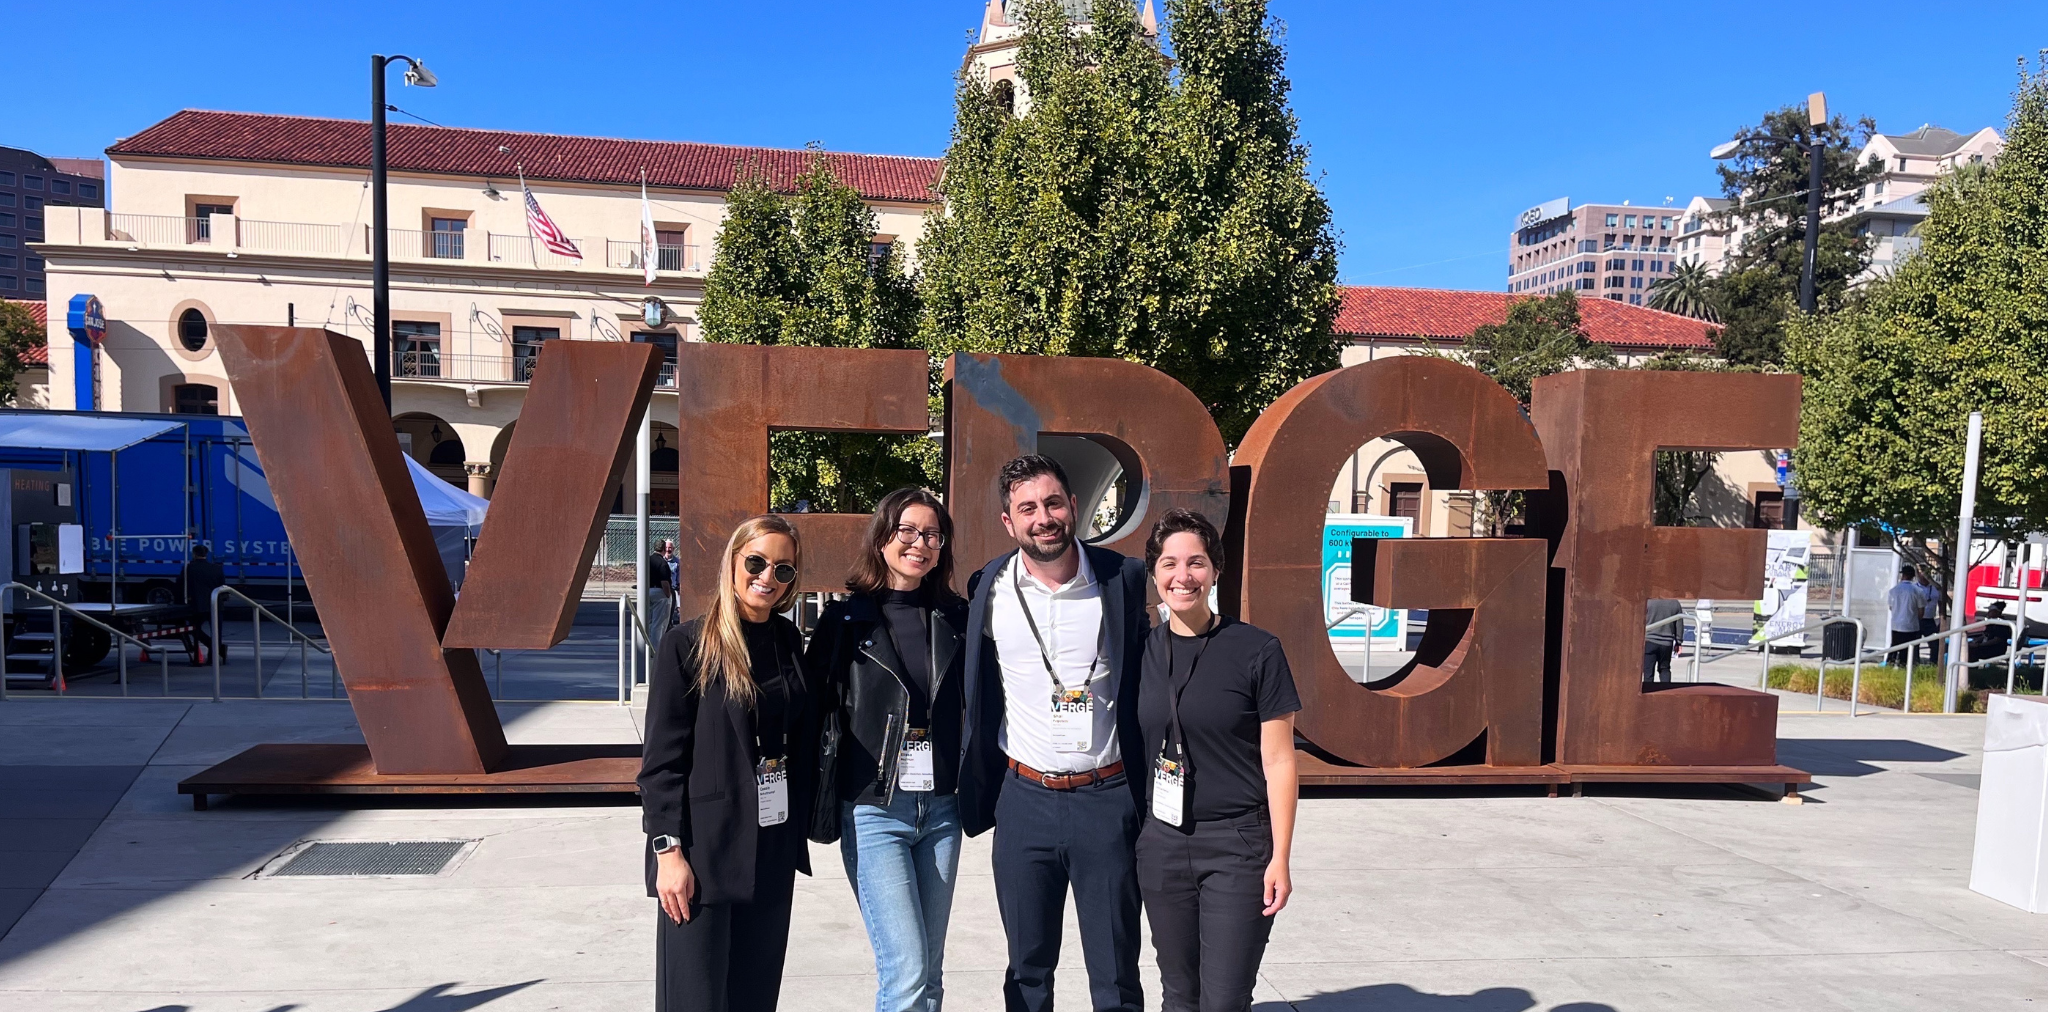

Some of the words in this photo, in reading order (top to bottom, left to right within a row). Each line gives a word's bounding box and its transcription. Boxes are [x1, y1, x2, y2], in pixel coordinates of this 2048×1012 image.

[15, 479, 50, 491] HEATING
[1330, 529, 1379, 537] Configurable
[83, 537, 127, 551] BLE
[1050, 701, 1094, 713] VERGE
[756, 770, 788, 786] VERGE
[1154, 767, 1184, 788] VERGE
